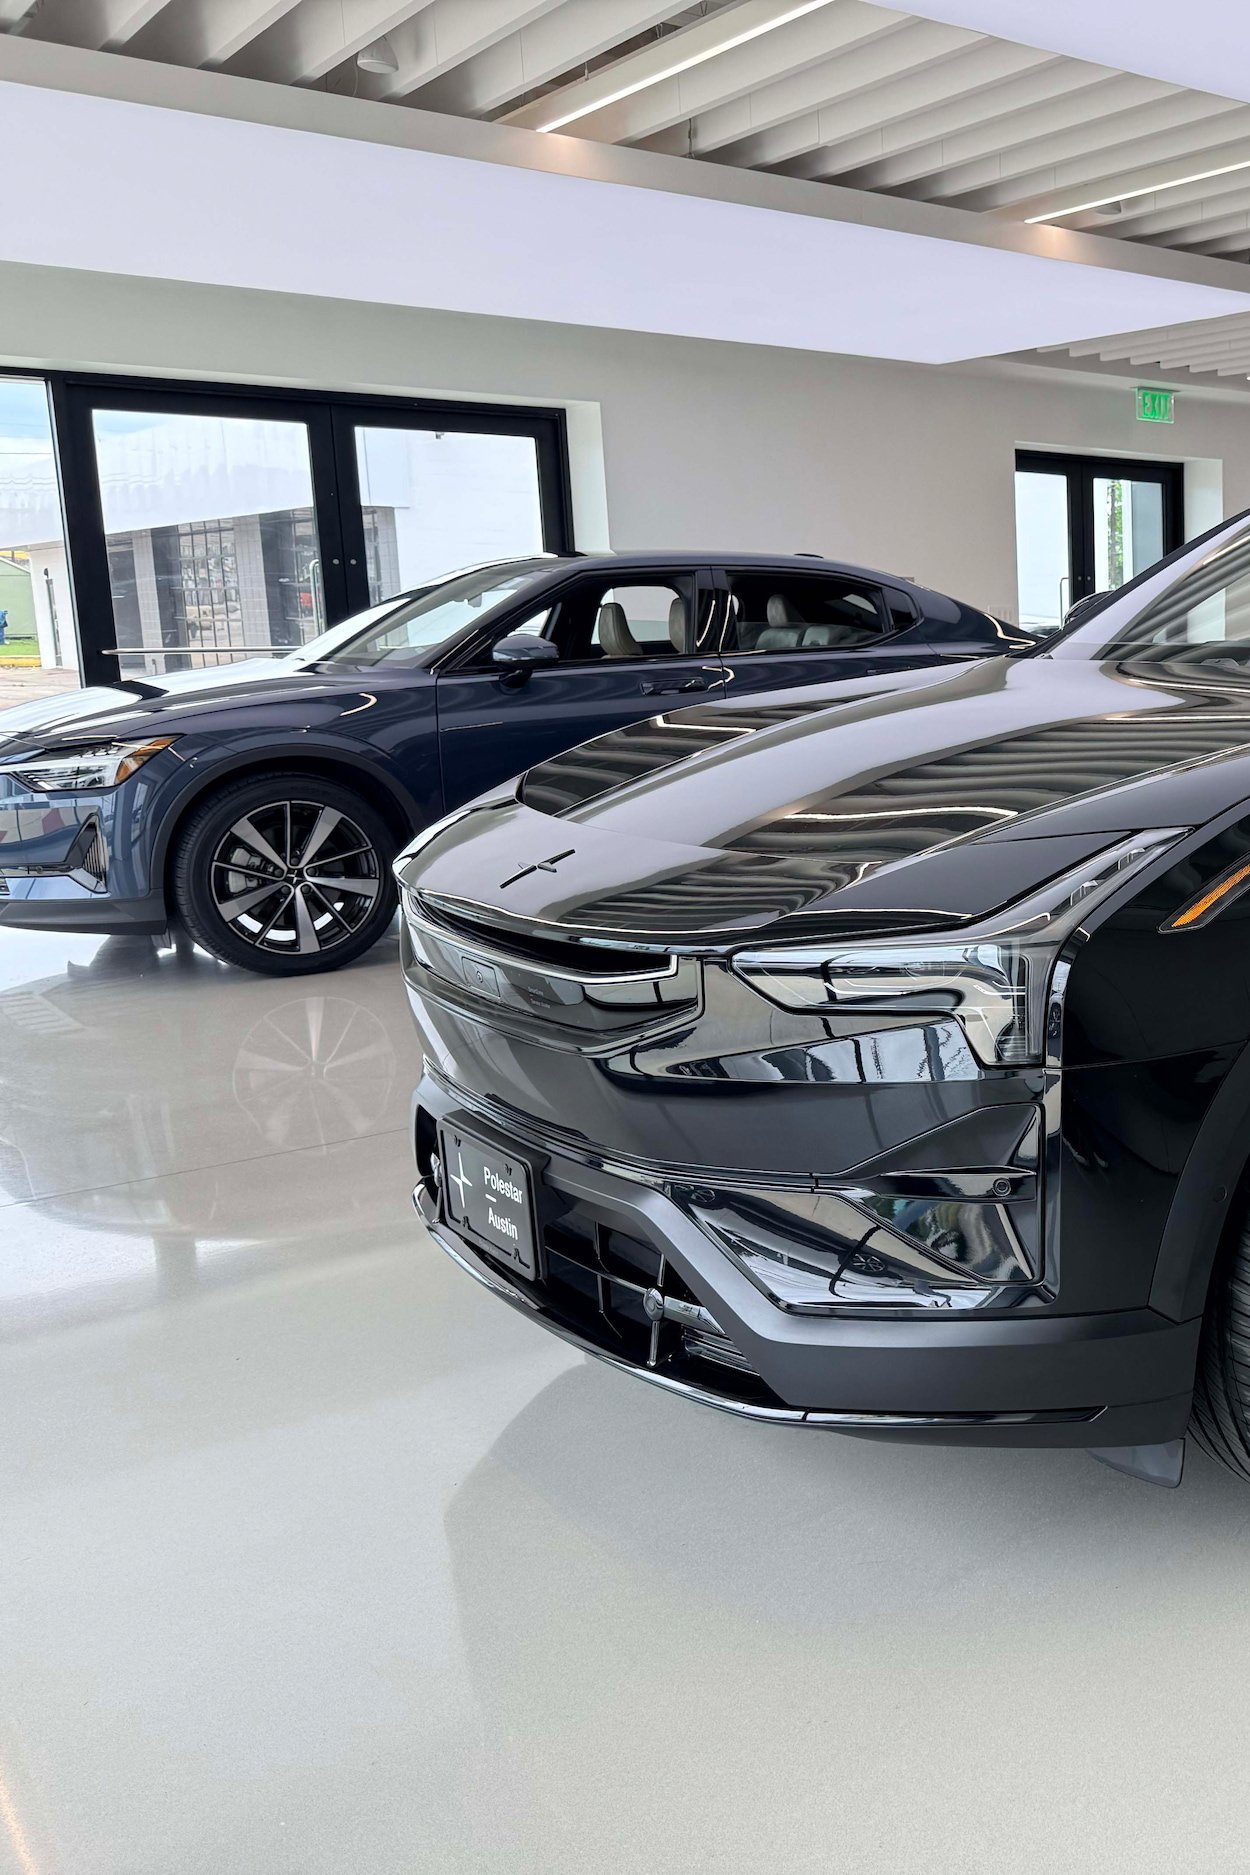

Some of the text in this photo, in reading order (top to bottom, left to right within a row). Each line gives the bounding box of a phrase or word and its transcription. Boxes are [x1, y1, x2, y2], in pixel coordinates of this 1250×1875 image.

[1141, 390, 1169, 419] EXIT
[483, 1166, 523, 1204] Polestar
[488, 1206, 519, 1241] Austin
